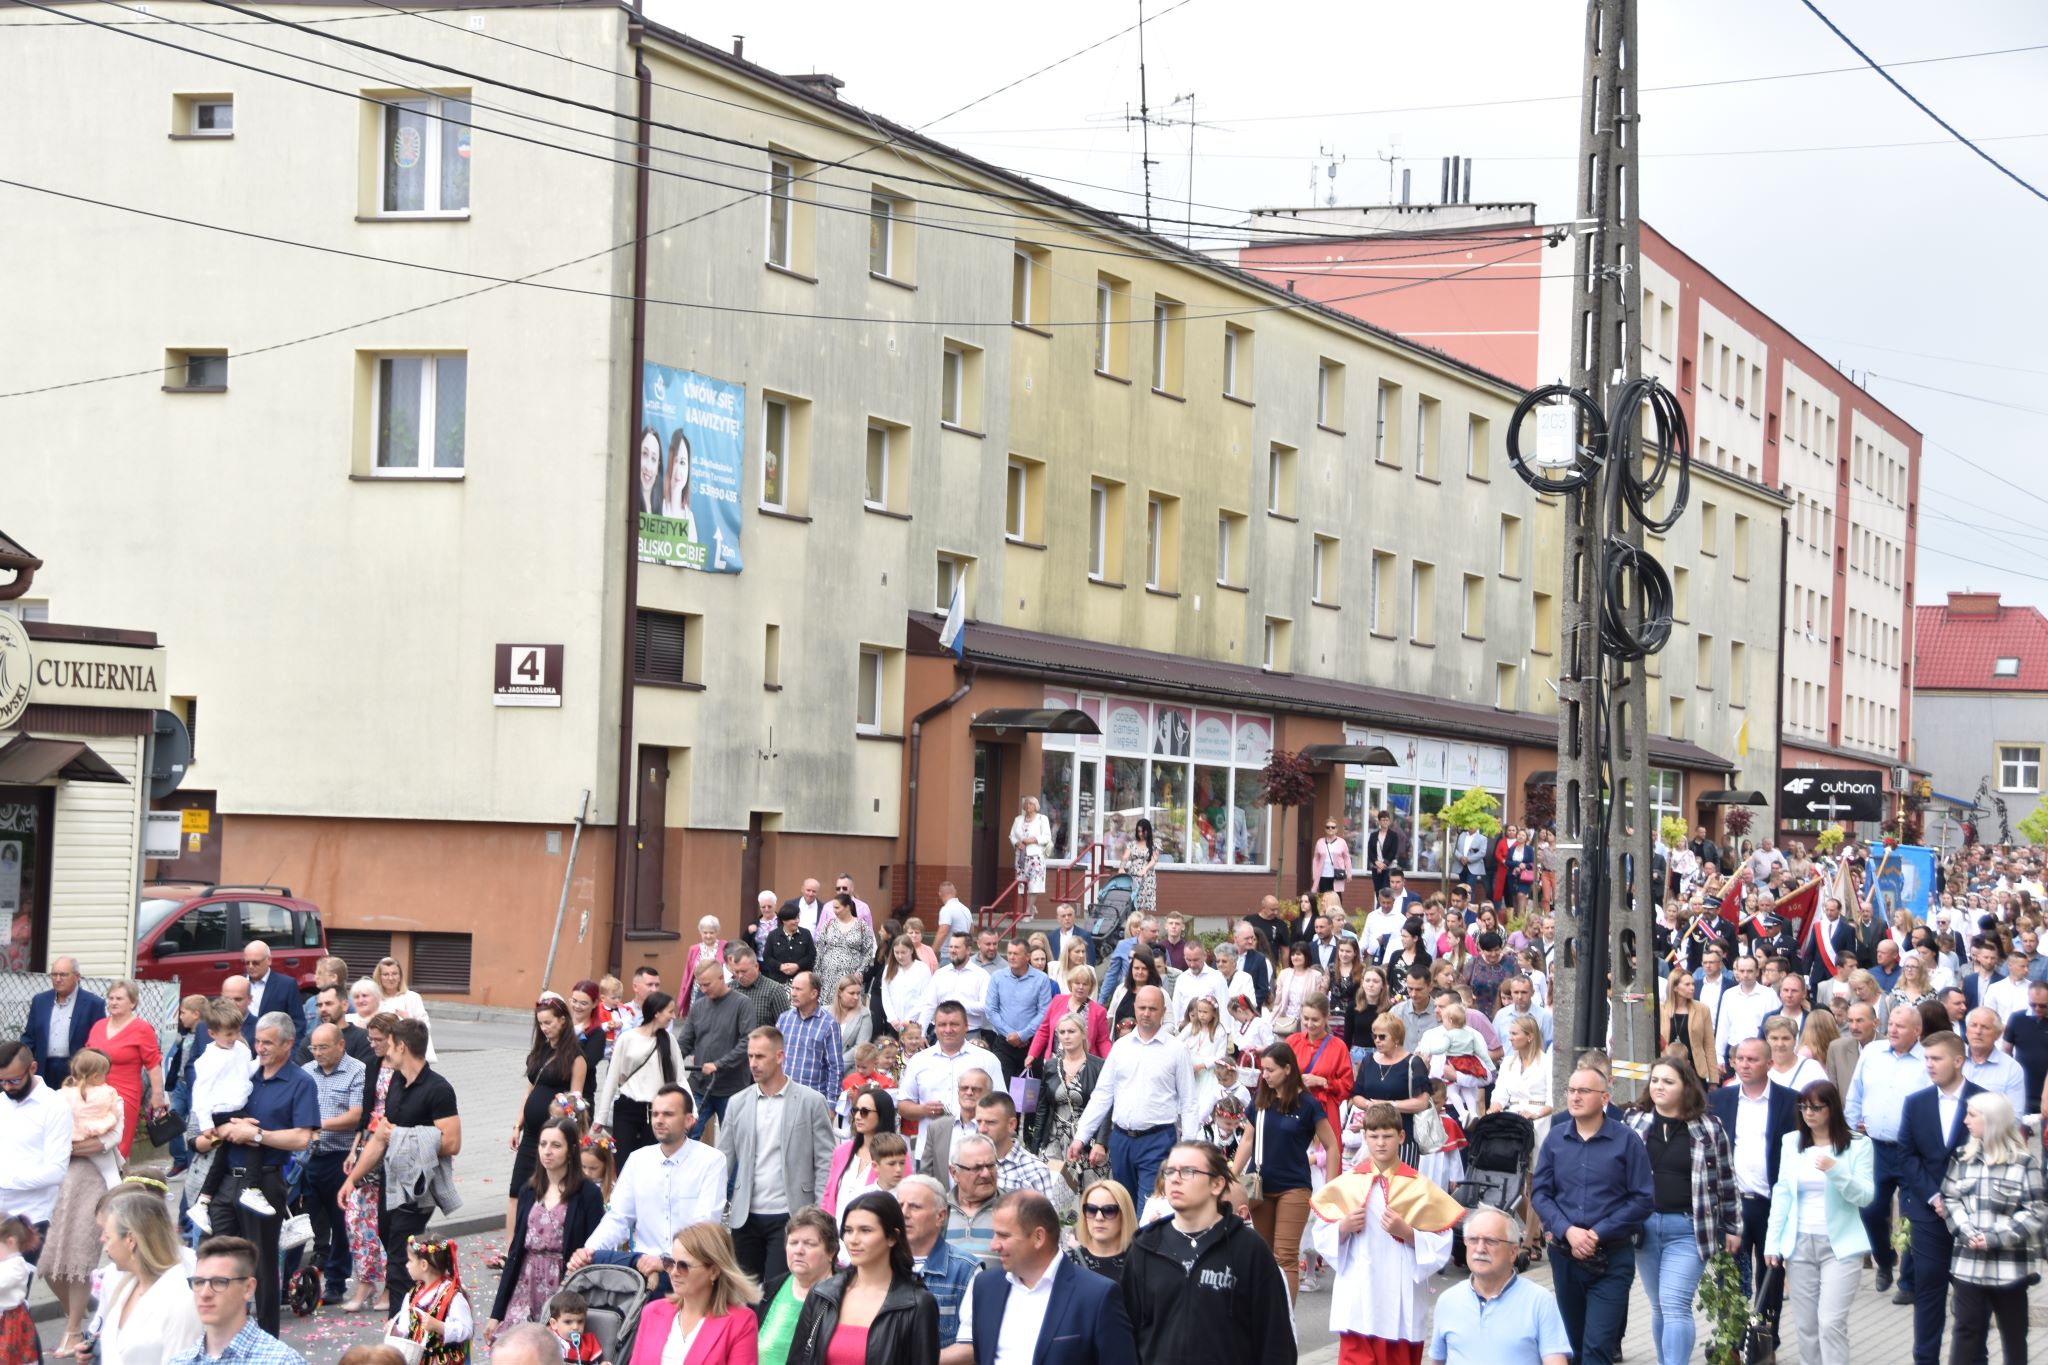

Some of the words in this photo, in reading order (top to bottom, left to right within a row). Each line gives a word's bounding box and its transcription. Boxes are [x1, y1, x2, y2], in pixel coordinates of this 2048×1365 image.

[639, 516, 688, 537] DIETETYK
[638, 536, 672, 557] BLISKO
[37, 658, 157, 692] CUKIERNIA
[517, 650, 539, 681] 4
[507, 686, 557, 694] JAGIELLOŃSKA
[1783, 778, 1814, 794] 4F
[1821, 781, 1875, 794] outhorn
